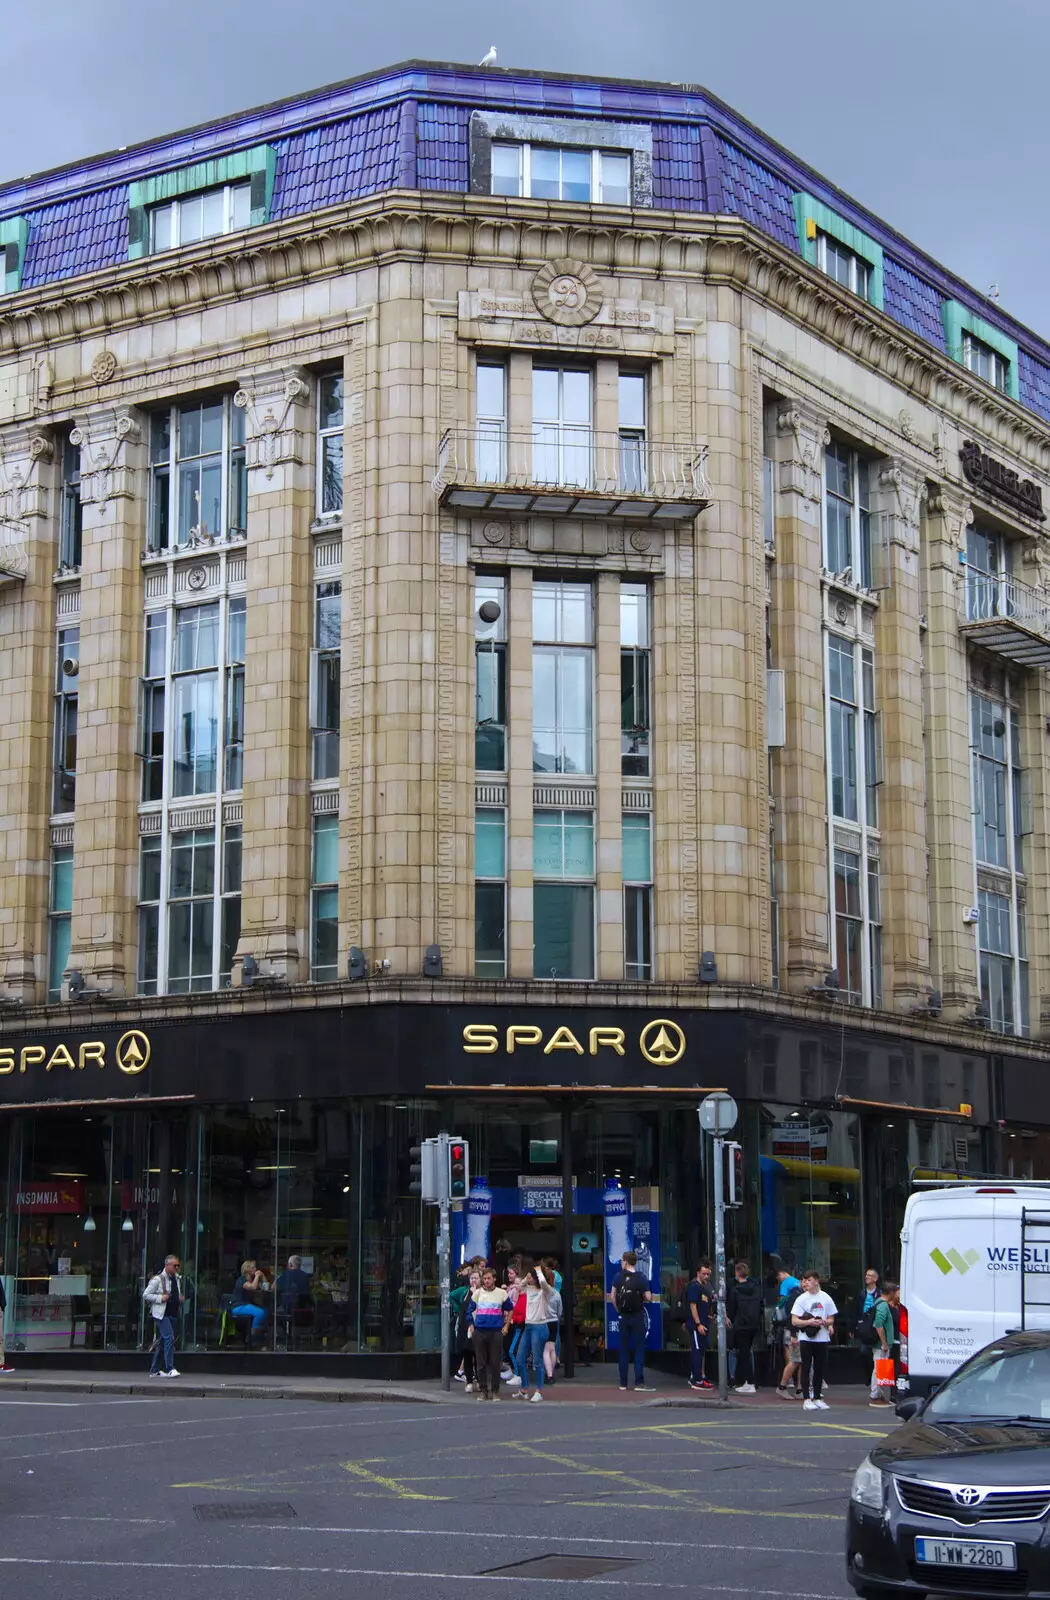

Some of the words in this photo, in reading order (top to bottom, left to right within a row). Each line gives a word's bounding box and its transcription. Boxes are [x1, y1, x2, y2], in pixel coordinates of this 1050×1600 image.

[609, 310, 651, 322] ERECTED
[520, 327, 553, 340] 1900
[585, 333, 613, 344] 1929
[463, 1024, 626, 1056] SPAR
[0, 1041, 106, 1076] SPAR
[16, 1191, 59, 1205] INSOMNIA
[527, 1191, 563, 1199] RECYCL
[527, 1198, 563, 1208] BOTTL
[939, 1337, 946, 1345] 01
[934, 1546, 1003, 1566] 11-WW-2280
